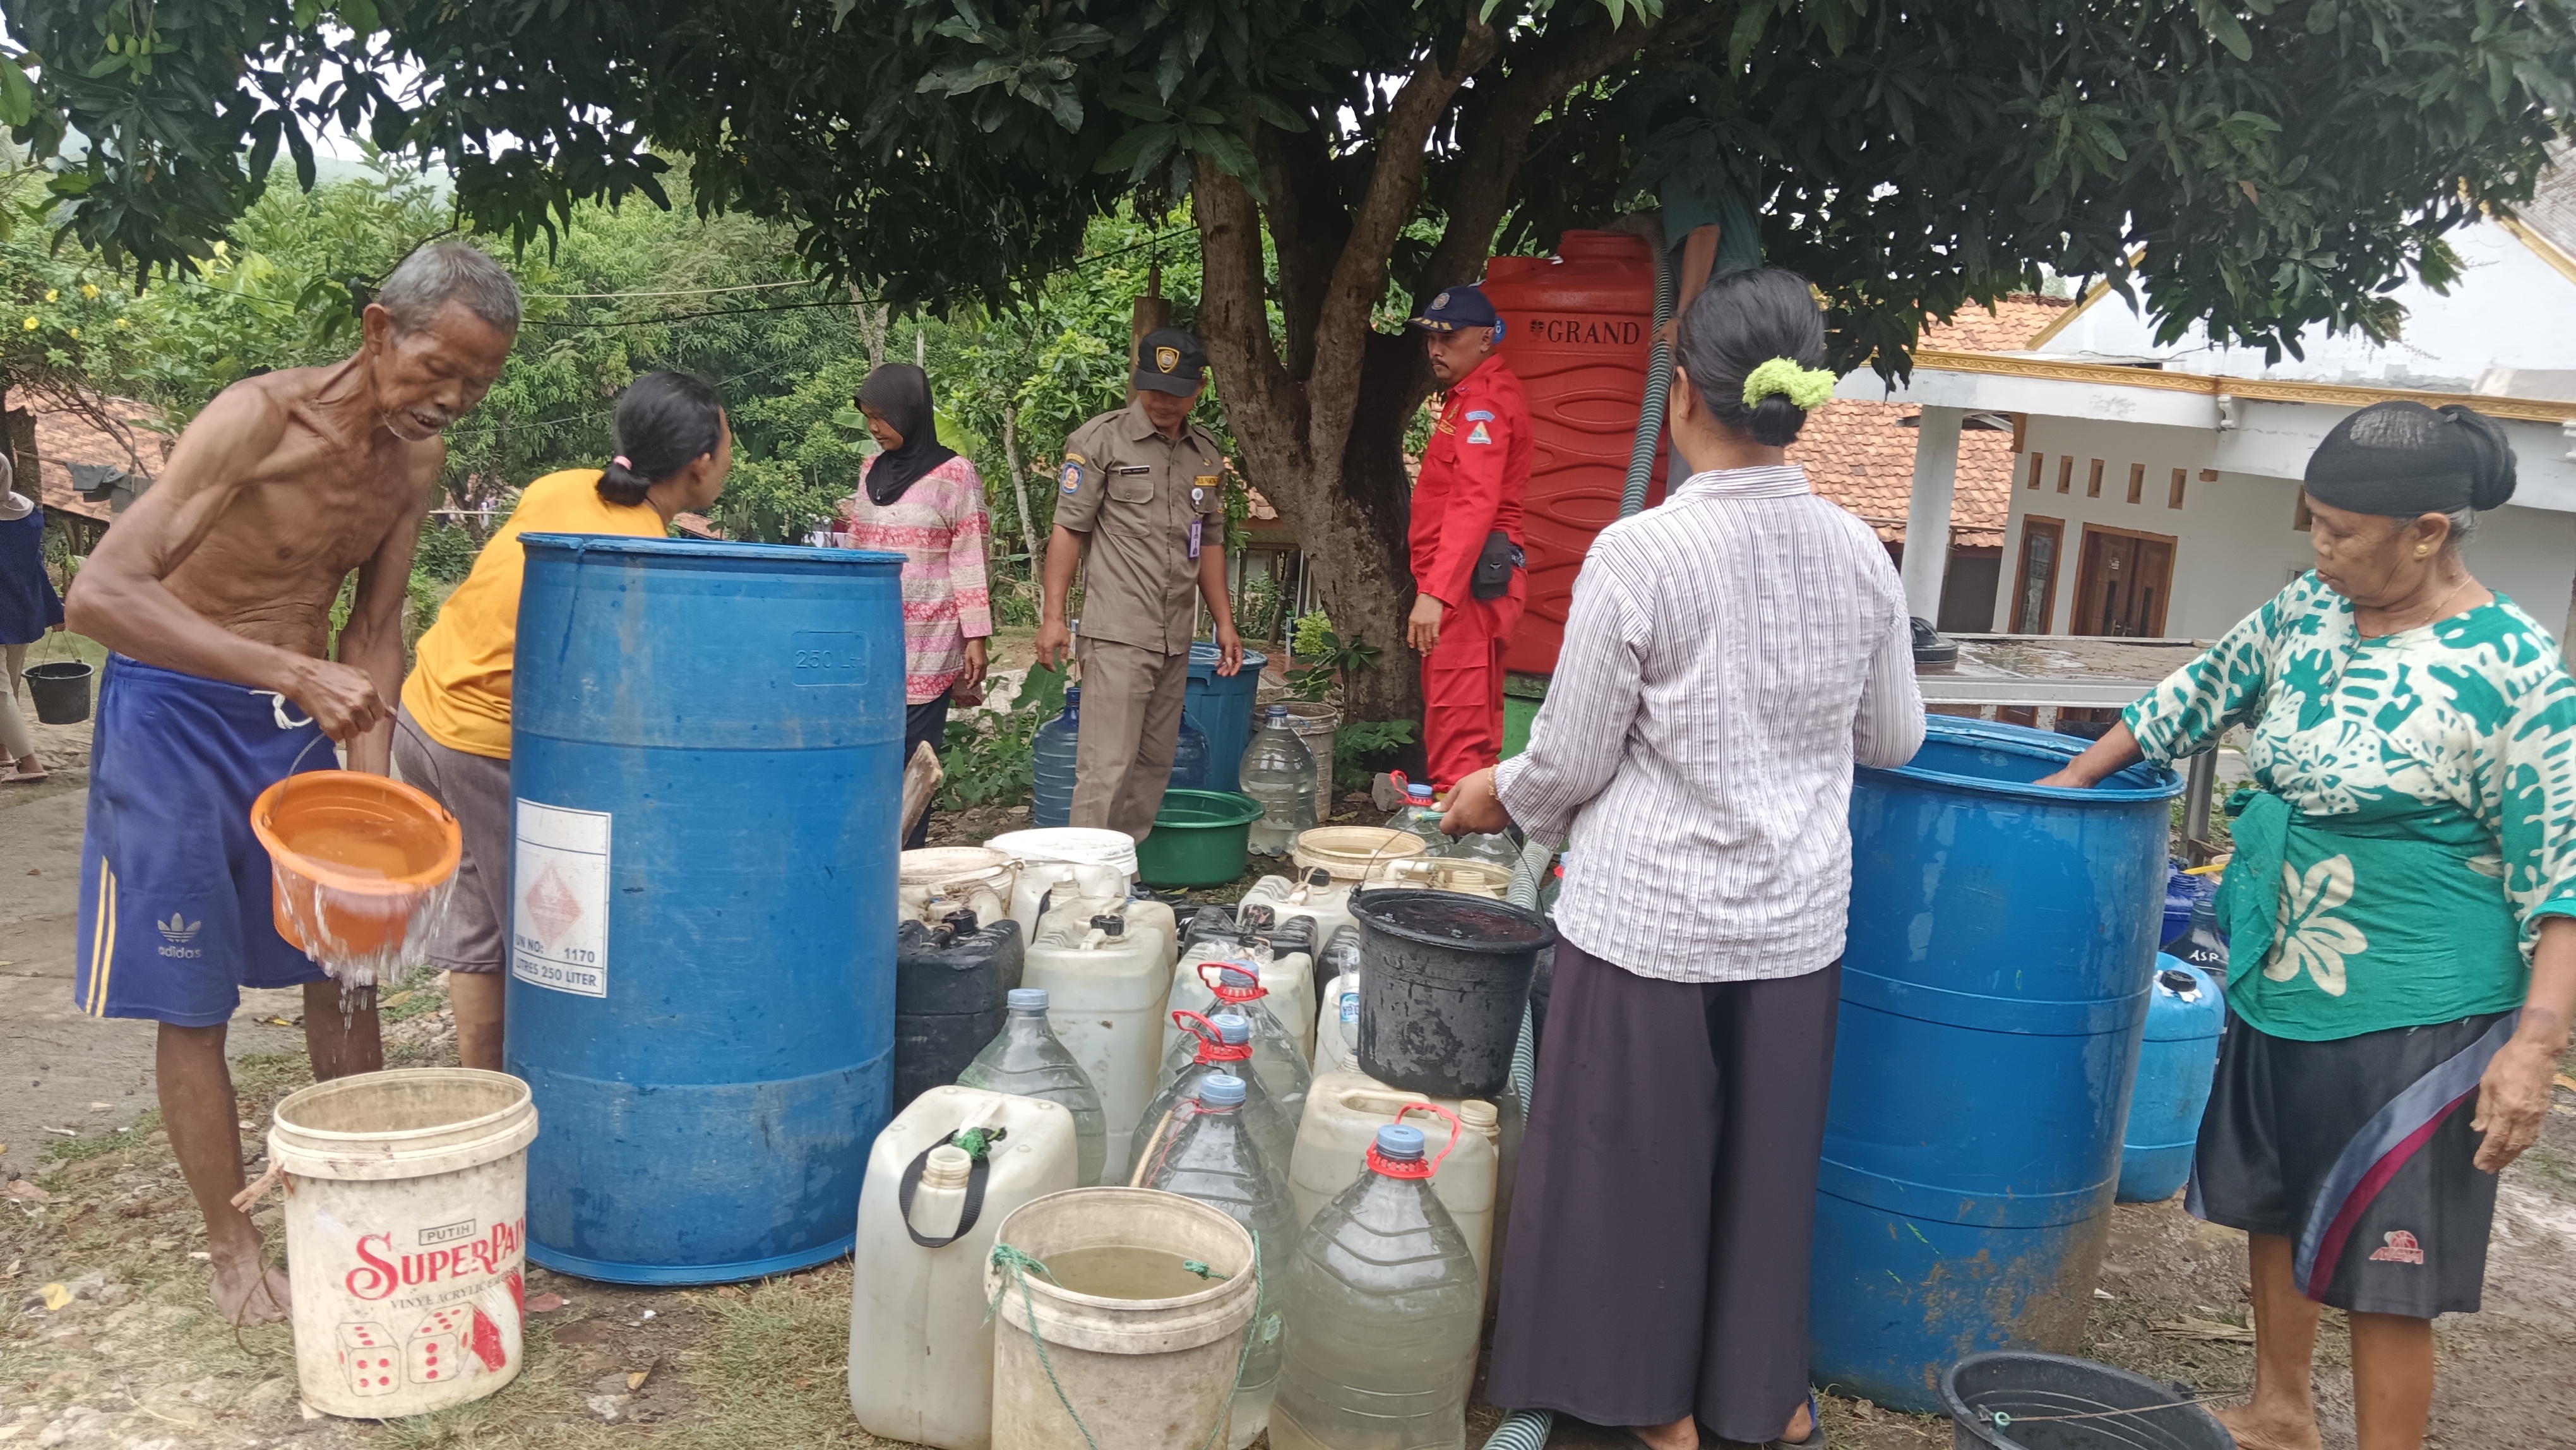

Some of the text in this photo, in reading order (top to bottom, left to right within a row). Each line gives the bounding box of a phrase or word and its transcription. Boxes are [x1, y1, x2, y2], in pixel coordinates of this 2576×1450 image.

[1547, 319, 1640, 345] GRAND
[795, 649, 833, 669] 250
[158, 945, 201, 959] adidas
[527, 938, 544, 954] NO:
[564, 947, 595, 963] 1170
[541, 965, 563, 981] 250
[566, 971, 597, 987] LITER
[427, 1225, 470, 1241] PUTIH
